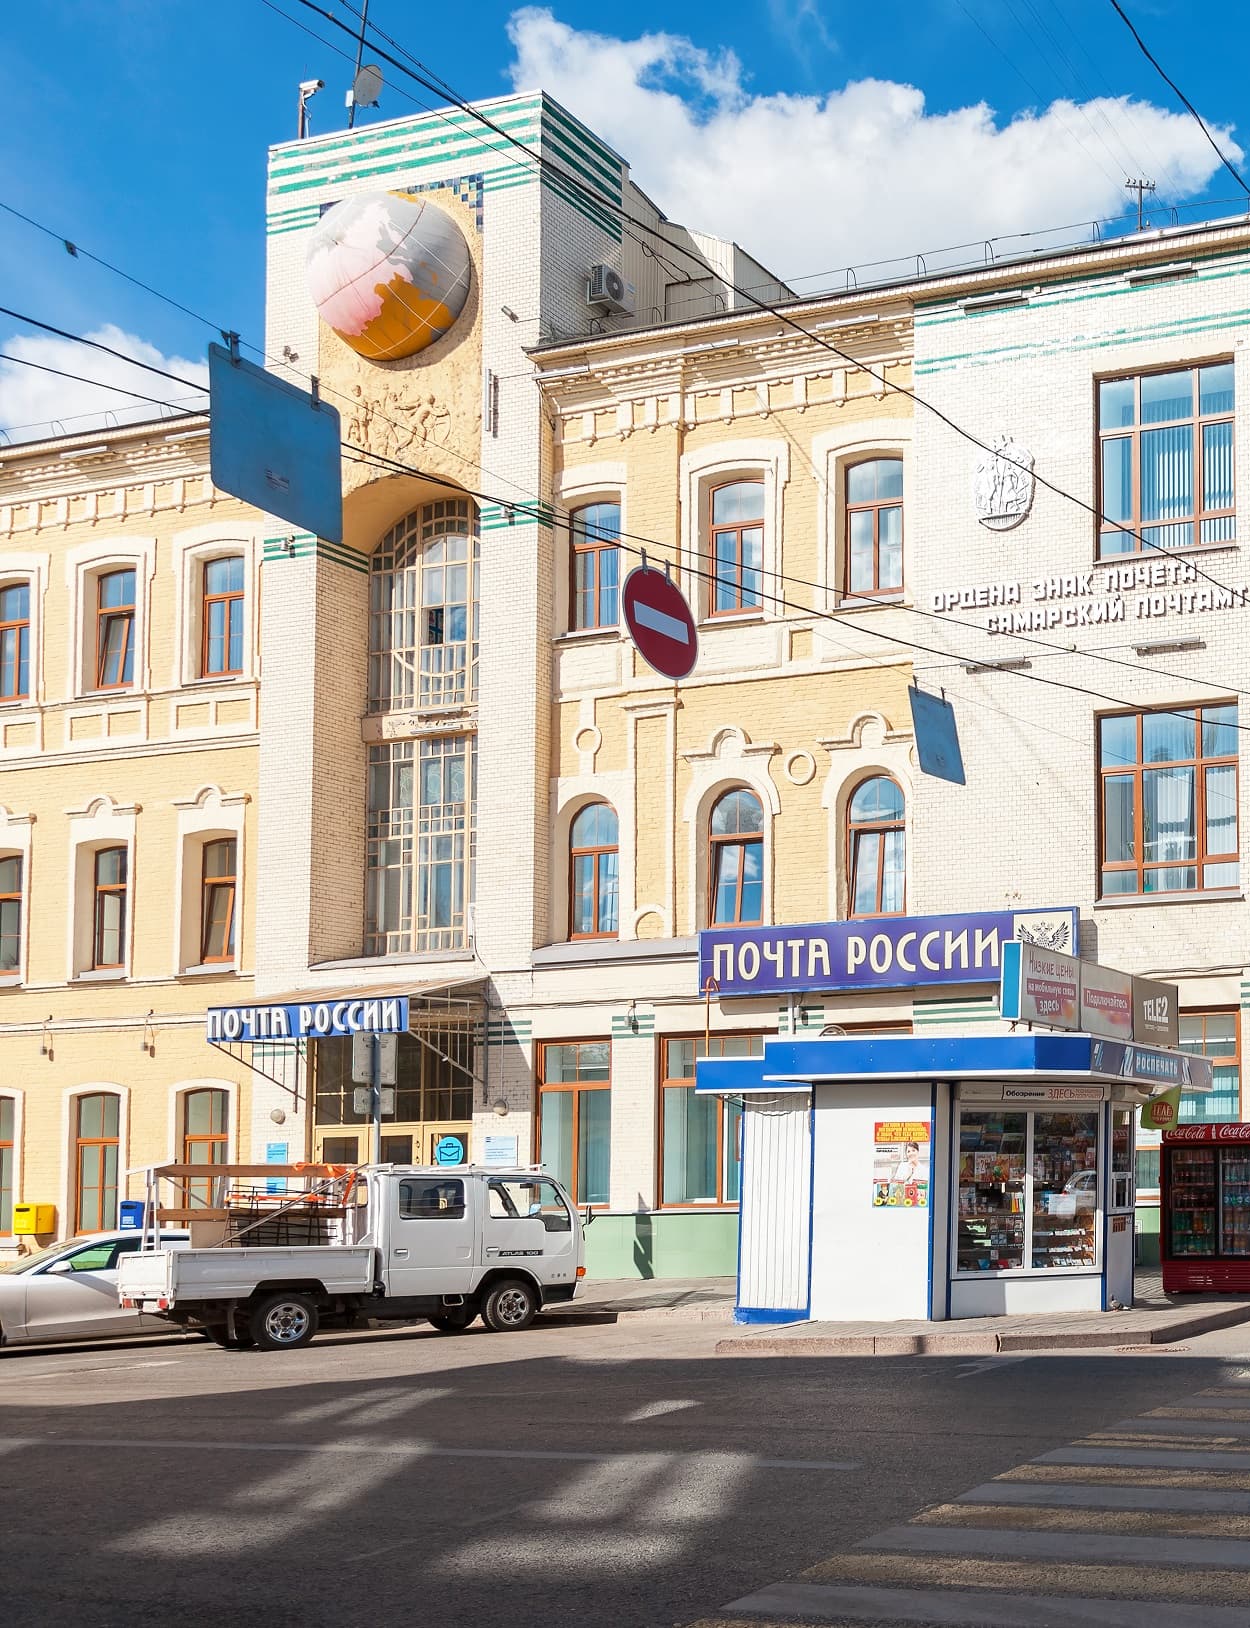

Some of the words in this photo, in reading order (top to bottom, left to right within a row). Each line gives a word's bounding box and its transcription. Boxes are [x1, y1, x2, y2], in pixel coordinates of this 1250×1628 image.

[931, 582, 1021, 612] ОРДЕНА
[1032, 574, 1094, 600] ЗНАК
[1103, 561, 1198, 592] ПОЧЕТА
[987, 596, 1126, 635] САМАРСКИЙ
[1136, 585, 1249, 619] ПОЧТАМТ
[713, 938, 831, 981] ПОЧТА
[847, 927, 999, 975] РОССИИ
[1034, 983, 1062, 1000] мобильную
[1062, 988, 1075, 997] связь
[1086, 990, 1128, 1010] Подключайтесь
[208, 1007, 291, 1040] ПОЧТА
[300, 999, 401, 1035] РОССИИ
[1039, 999, 1060, 1015] здесь
[1143, 996, 1168, 1024] TELE2
[1136, 1053, 1178, 1076] РОСПЕЧАТЬ
[1047, 1088, 1075, 1100] ЗДЕСЬ
